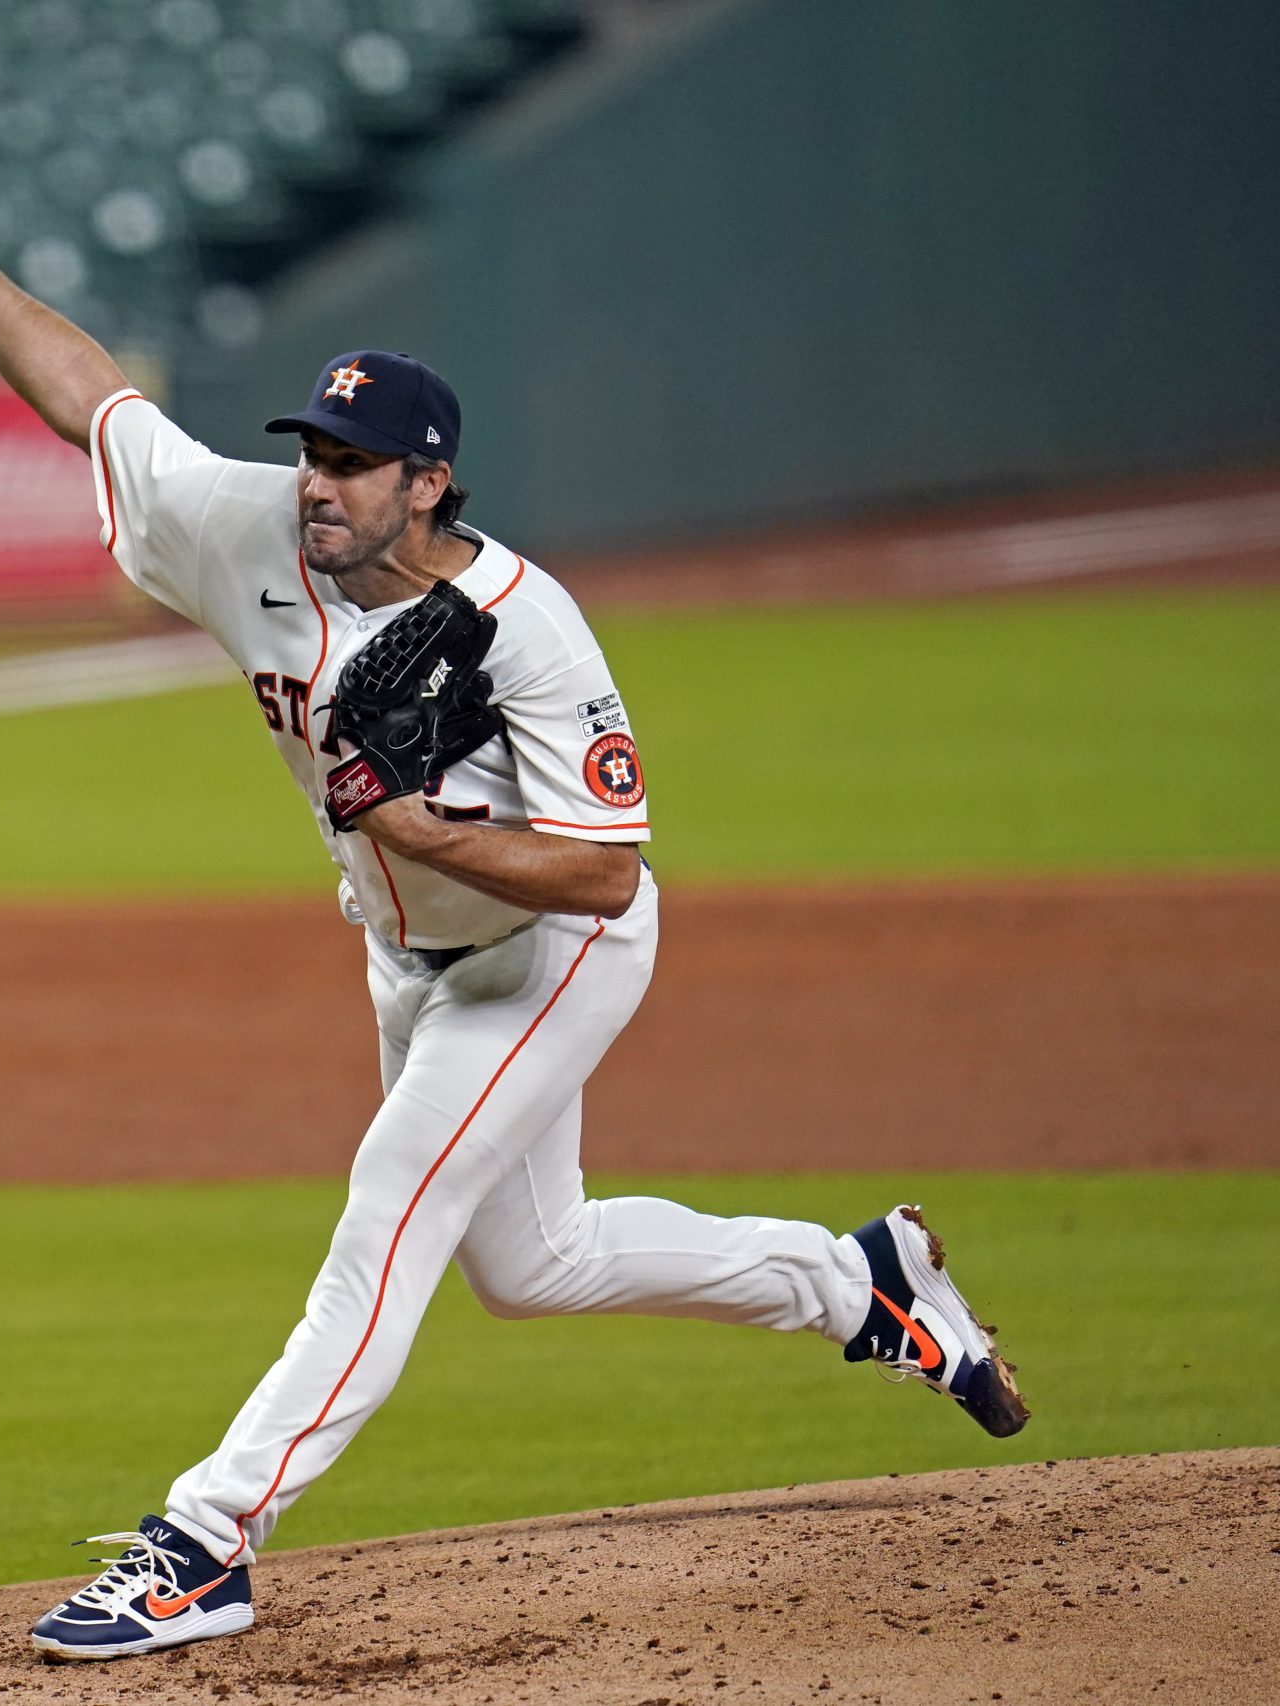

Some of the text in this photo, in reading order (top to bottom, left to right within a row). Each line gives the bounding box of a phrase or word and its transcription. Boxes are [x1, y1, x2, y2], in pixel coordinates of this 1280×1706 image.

[326, 367, 366, 399] H
[421, 657, 453, 698] VER
[605, 712, 621, 721] BLACK
[608, 721, 626, 730] MATTER
[590, 736, 635, 763] HOUSTON
[333, 772, 369, 804] Rawlings
[604, 783, 643, 805] ASTROS
[145, 1526, 172, 1543] JV
